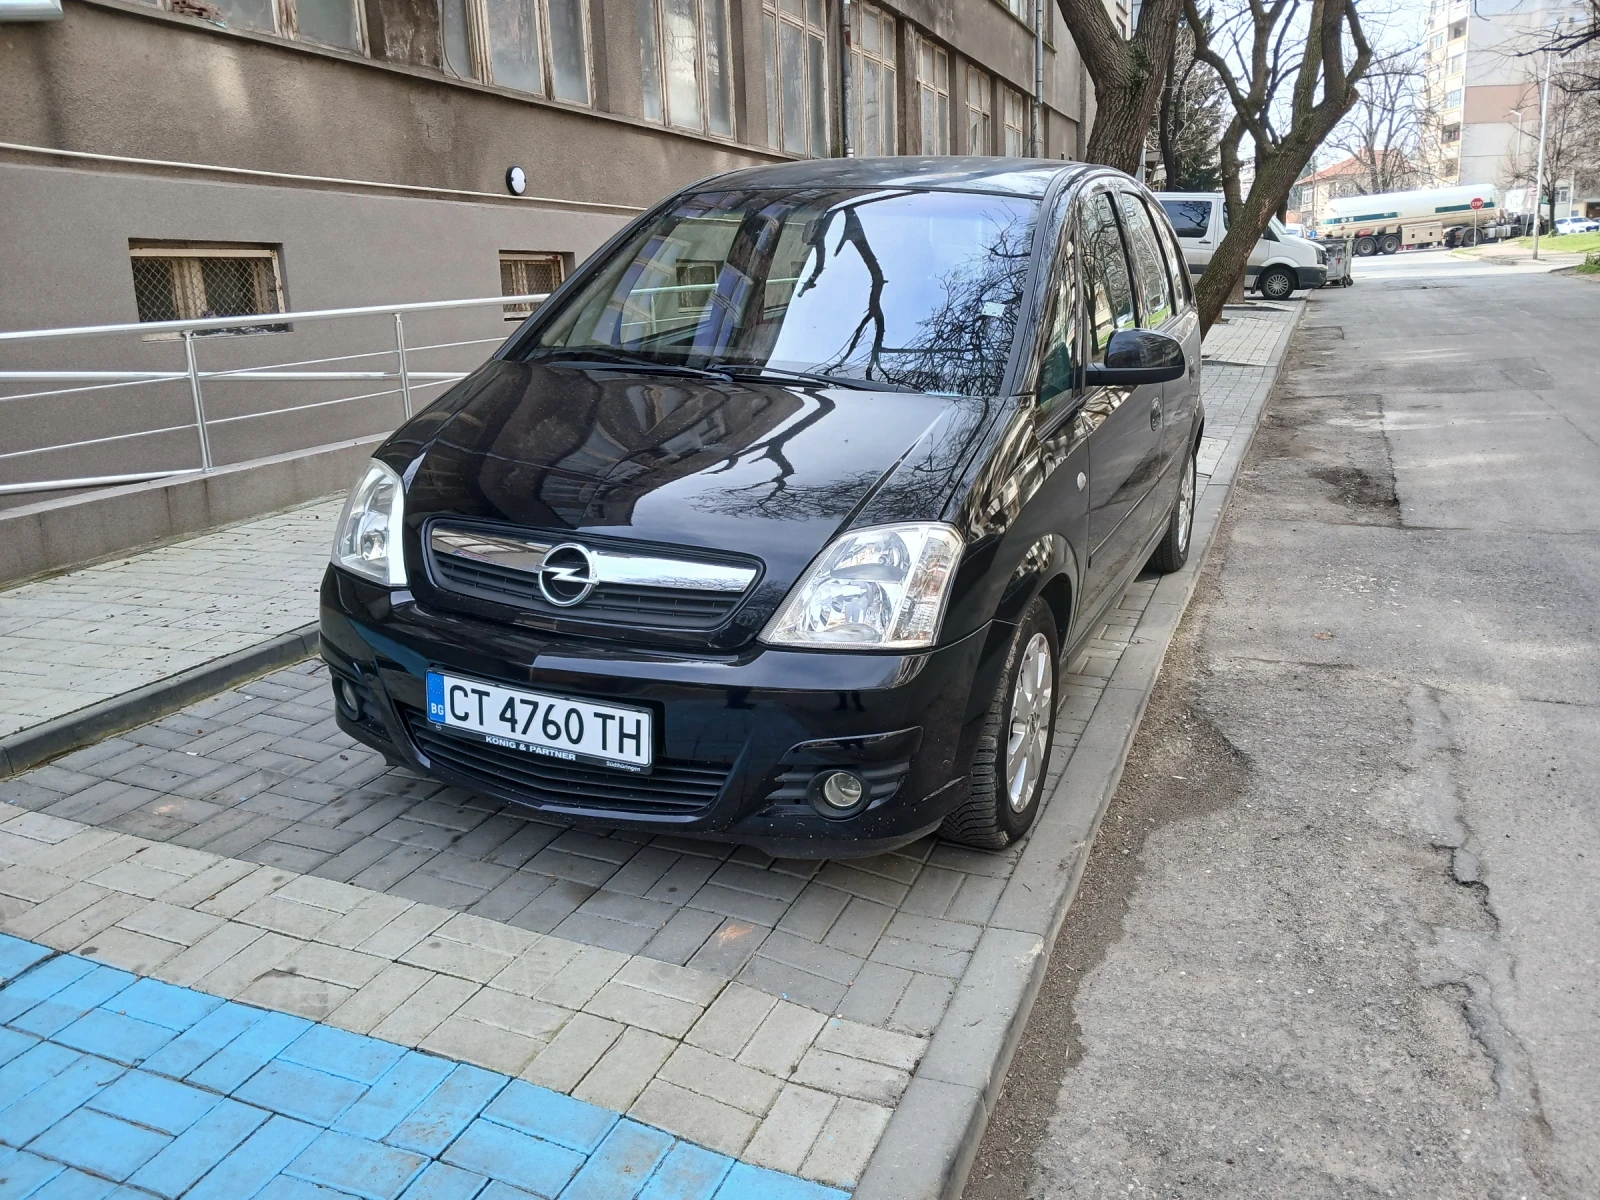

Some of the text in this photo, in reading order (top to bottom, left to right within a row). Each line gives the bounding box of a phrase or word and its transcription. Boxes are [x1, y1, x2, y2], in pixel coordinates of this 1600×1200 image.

[431, 702, 444, 716] BG
[449, 684, 642, 757] CT 4760 TH
[519, 743, 526, 751] &
[529, 745, 576, 761] PARTNER
